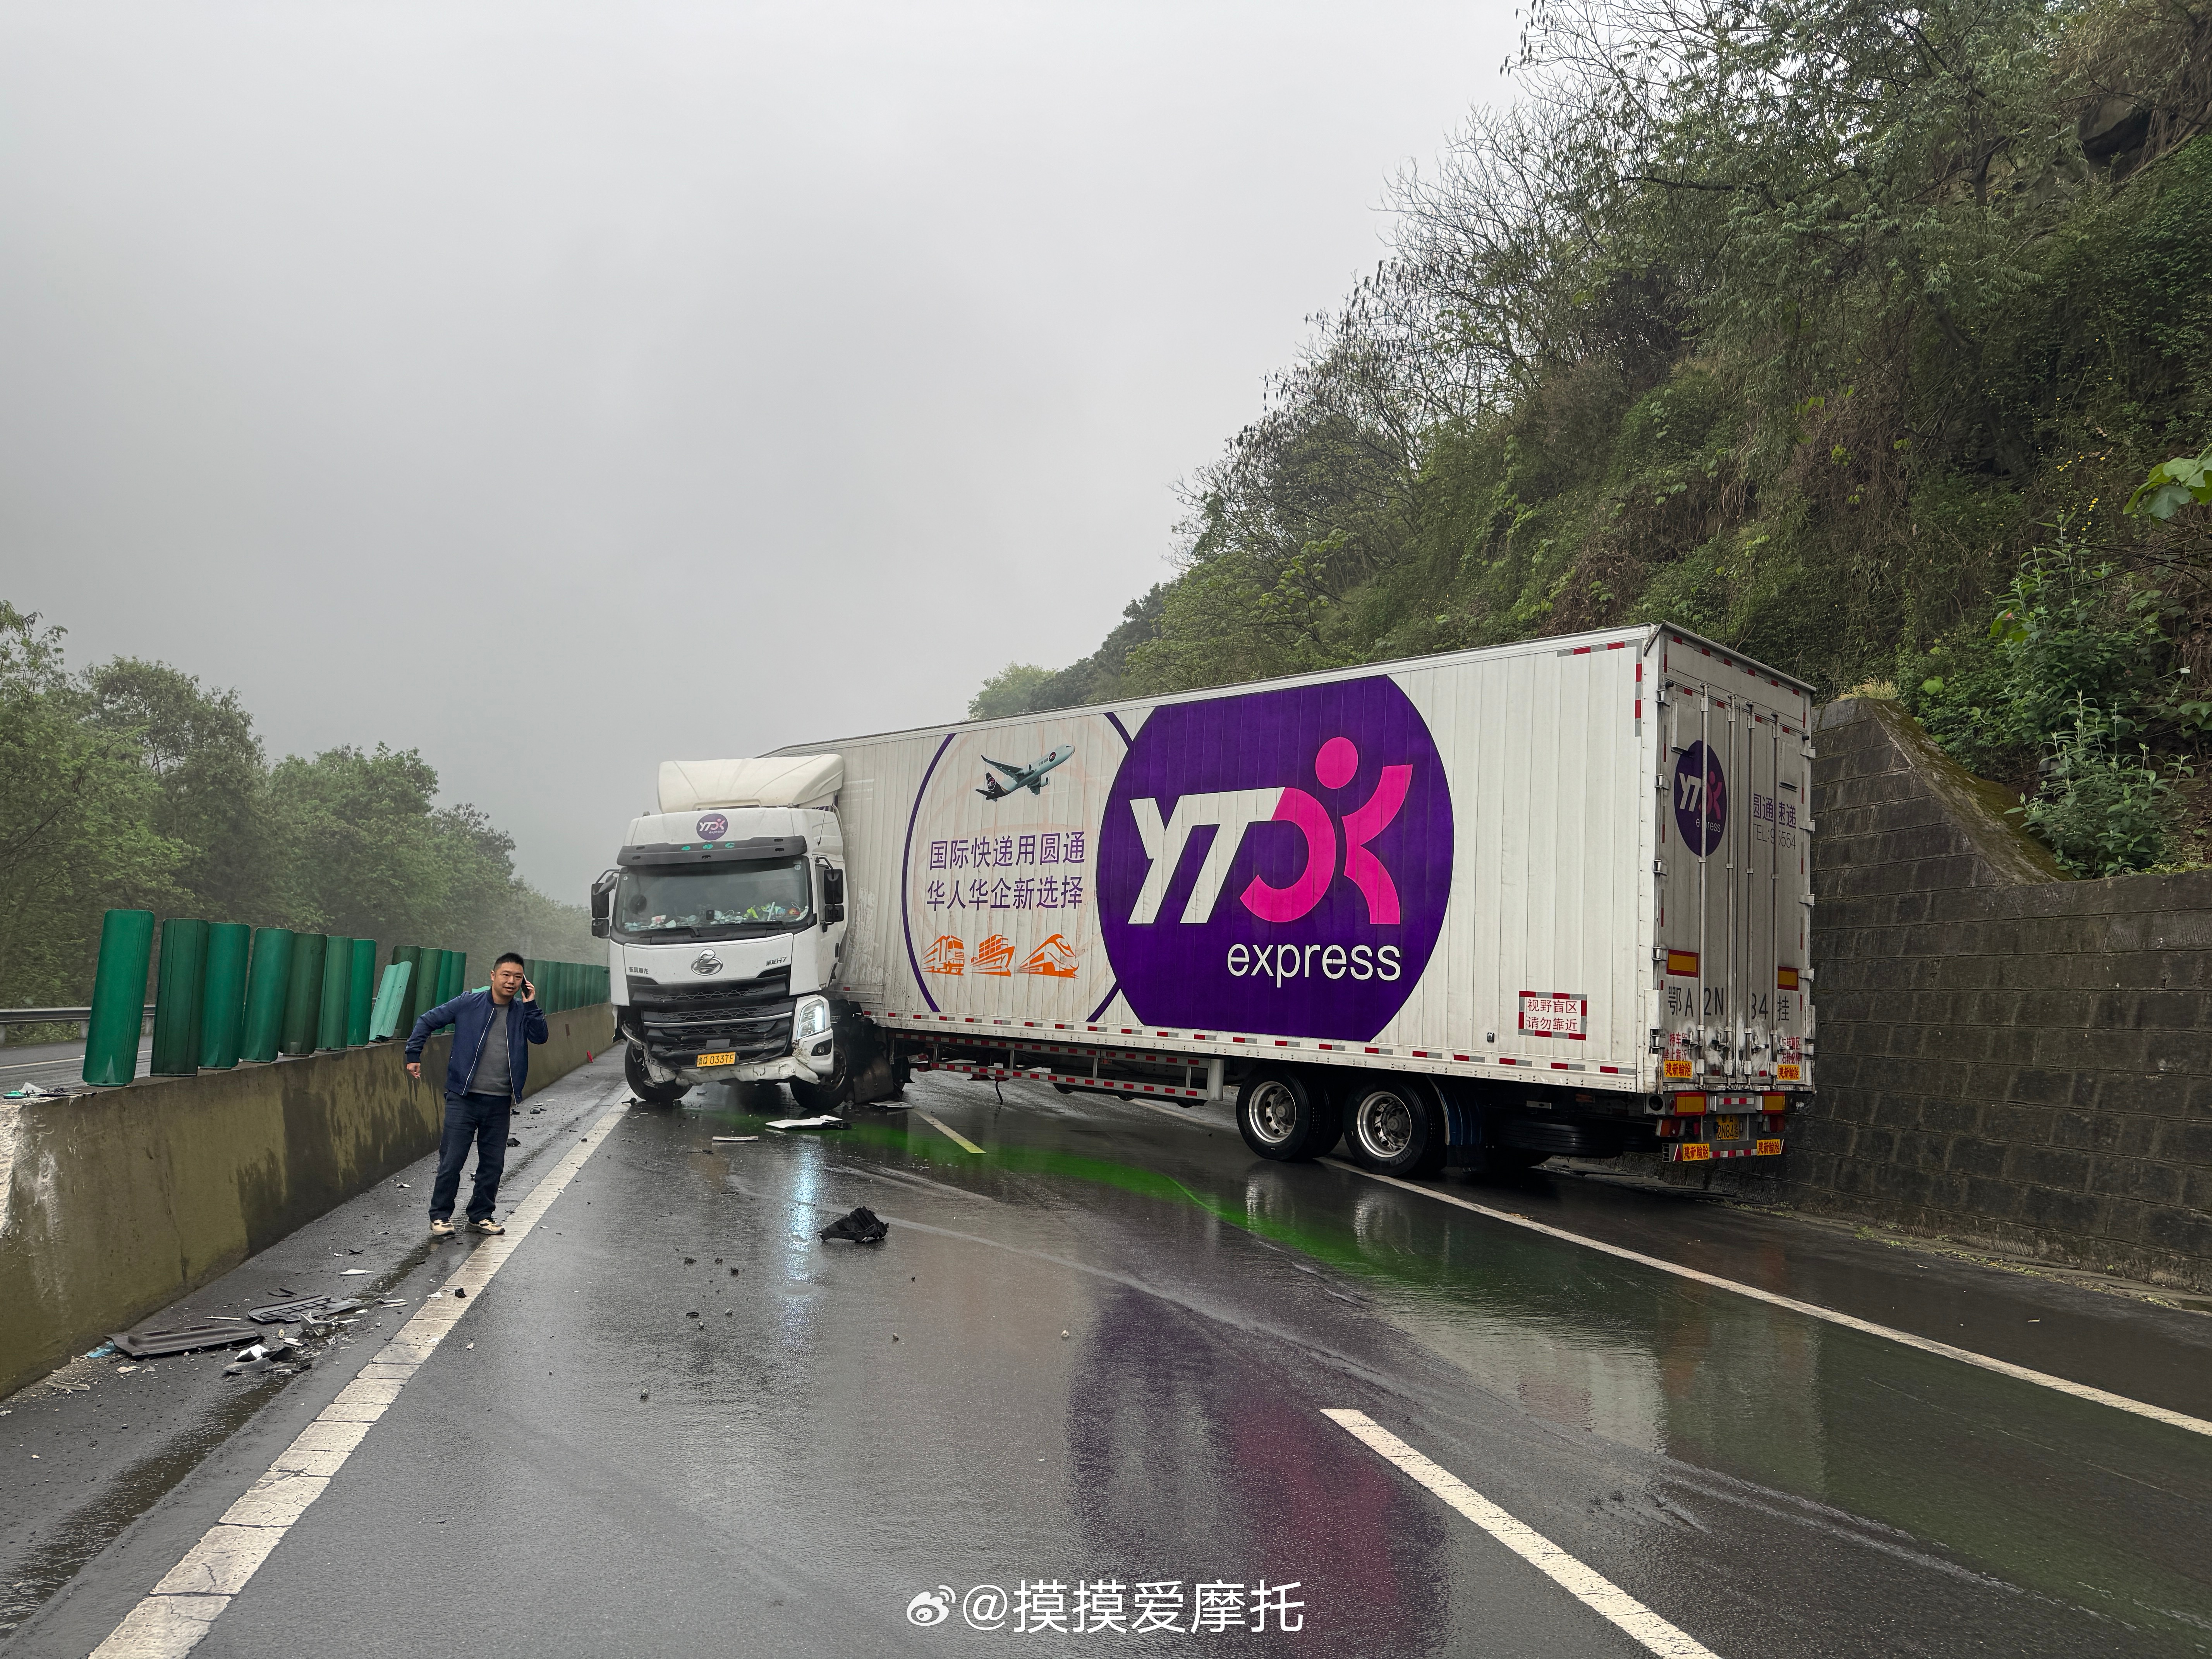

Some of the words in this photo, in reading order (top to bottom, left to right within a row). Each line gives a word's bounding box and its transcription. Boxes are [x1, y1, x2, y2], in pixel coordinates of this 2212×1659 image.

[1696, 819, 1721, 832] eress
[1753, 793, 1796, 829] 圆通速递
[929, 831, 1085, 871] 国际快递用圆通
[927, 876, 1084, 911] 华人华企新选择
[1228, 944, 1401, 988] express
[1527, 999, 1577, 1013] 视野盲区
[1527, 1017, 1577, 1031] 请勿靠近
